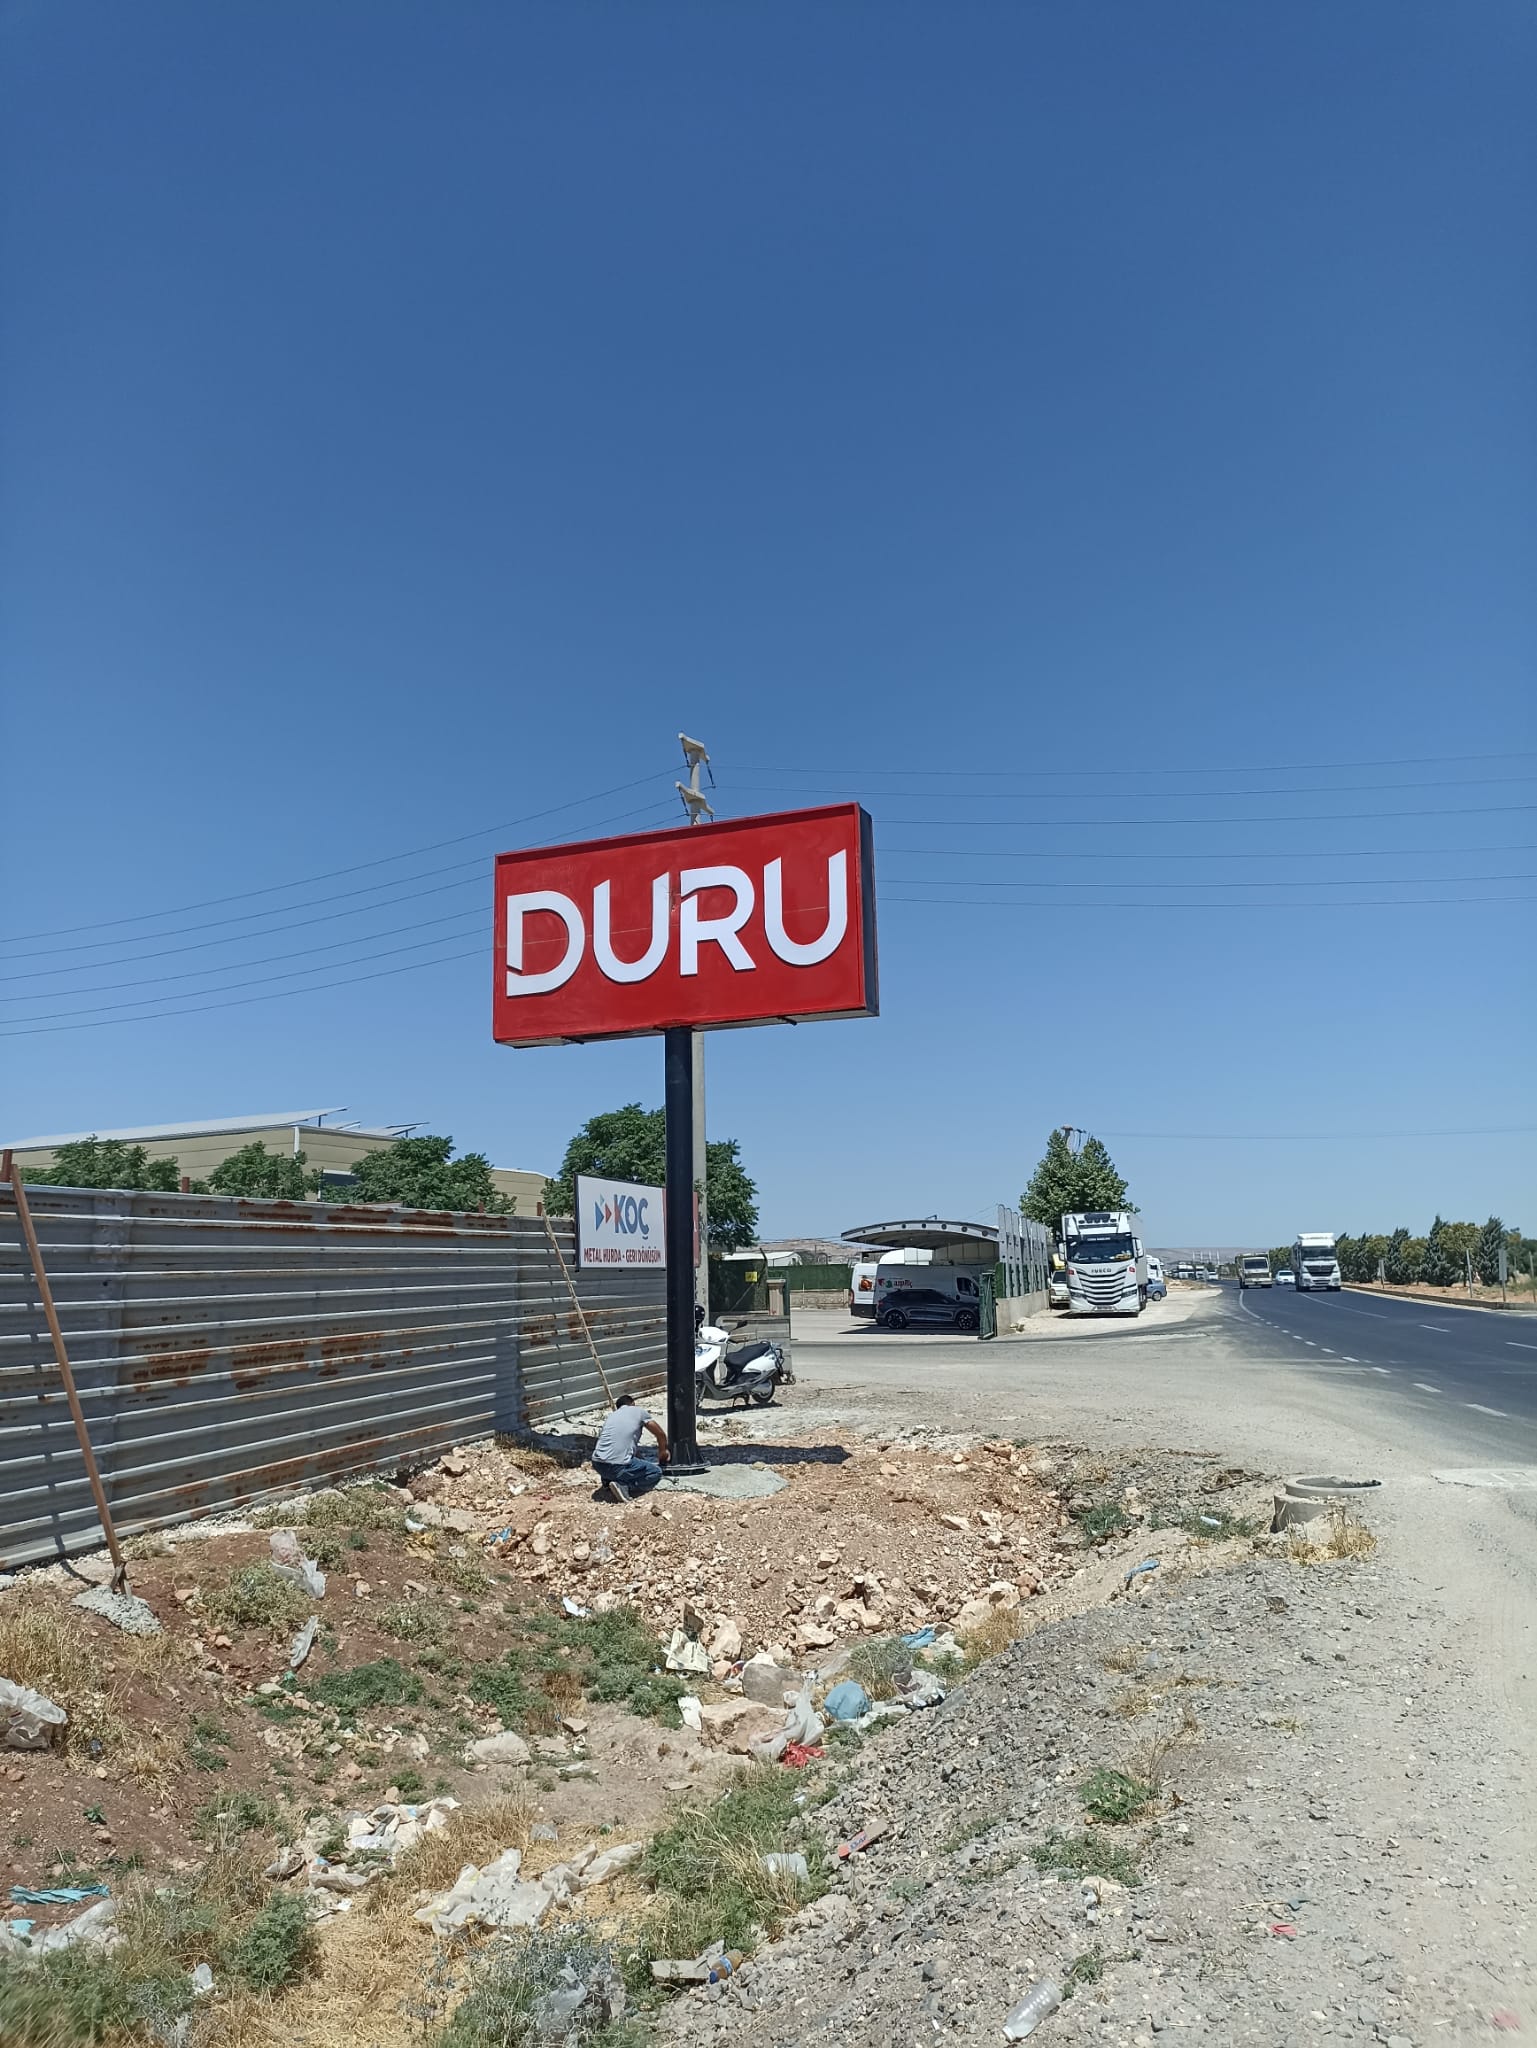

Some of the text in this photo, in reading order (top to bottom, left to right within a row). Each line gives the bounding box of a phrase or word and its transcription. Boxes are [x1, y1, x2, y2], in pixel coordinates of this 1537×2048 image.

[506, 849, 847, 997] DURU
[613, 1194, 650, 1240] KOÇ
[584, 1248, 602, 1263] METAL
[603, 1249, 621, 1263] HURDA
